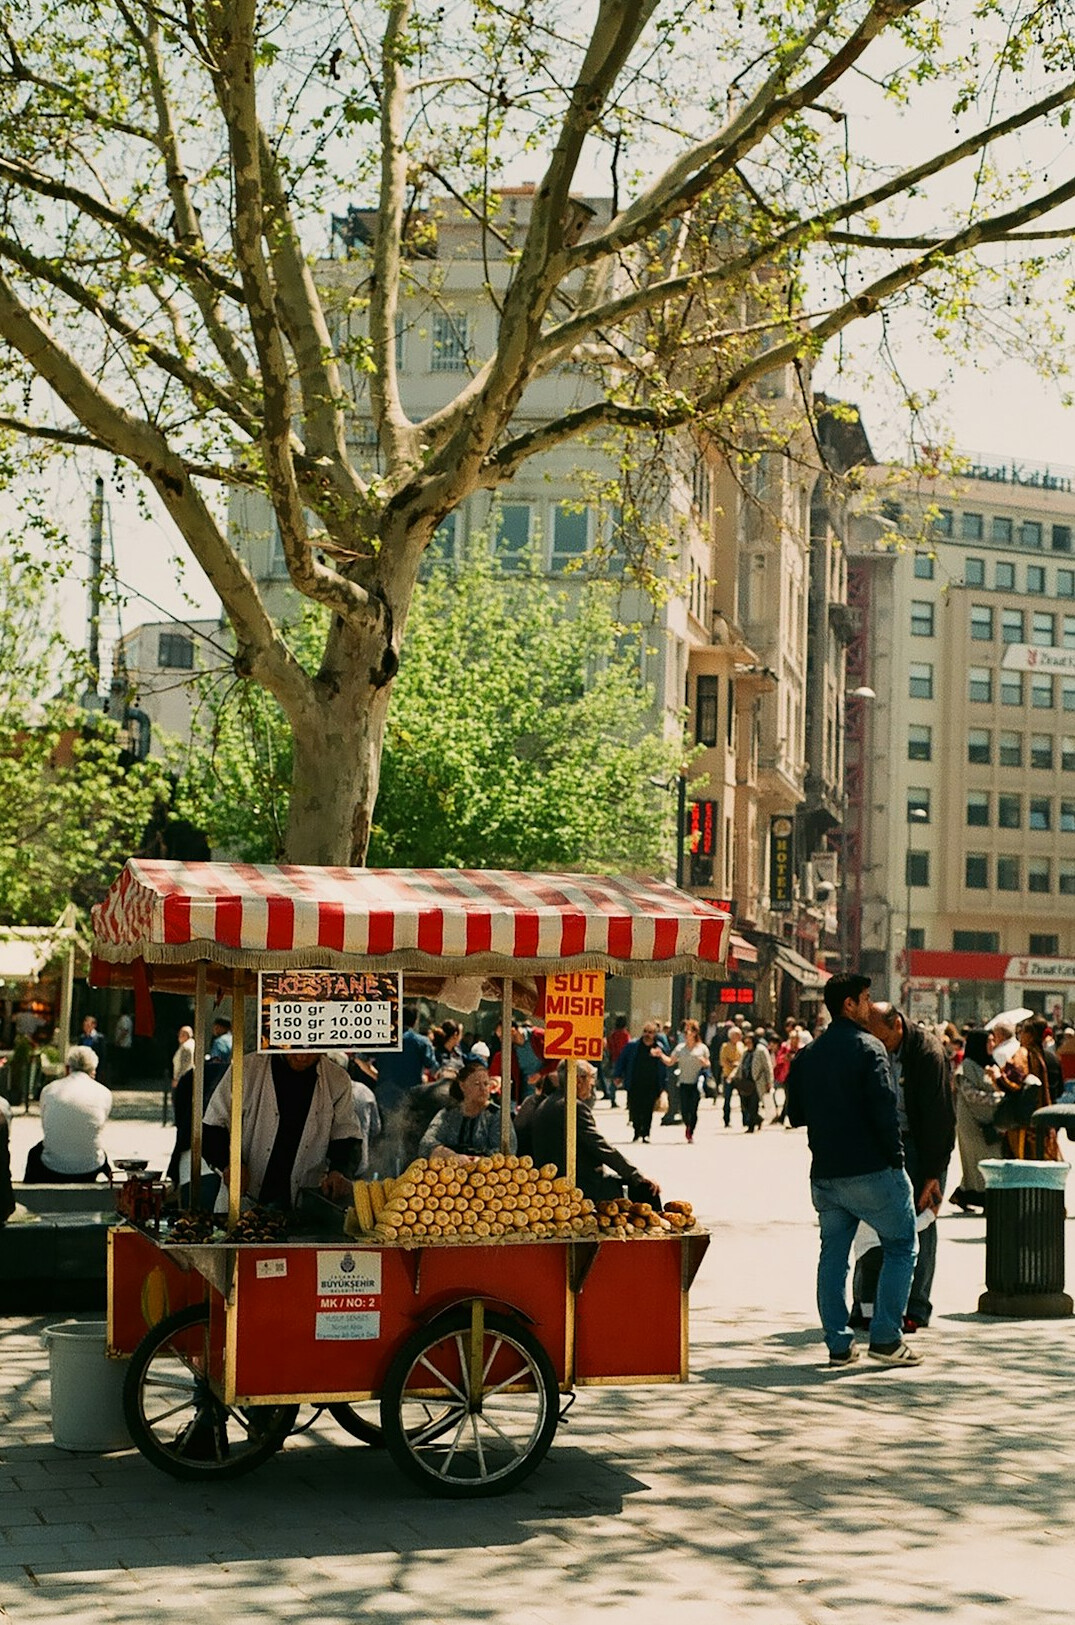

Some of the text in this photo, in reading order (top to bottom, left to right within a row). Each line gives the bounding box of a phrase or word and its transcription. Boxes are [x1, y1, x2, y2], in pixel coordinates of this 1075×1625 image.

[775, 839, 788, 900] HOTEL
[278, 975, 381, 995] KESTANE
[273, 1004, 302, 1014] 100
[307, 1006, 325, 1016] gr
[340, 1003, 373, 1014] 7.00
[546, 995, 604, 1017] MISIR
[274, 1016, 388, 1029] 150 gr 10.00 TL
[273, 1029, 388, 1042] 300 gr 20.00 TL
[321, 1278, 375, 1289] BÜYÜKŞEHİR
[320, 1298, 376, 1308] MK / NO: 2
